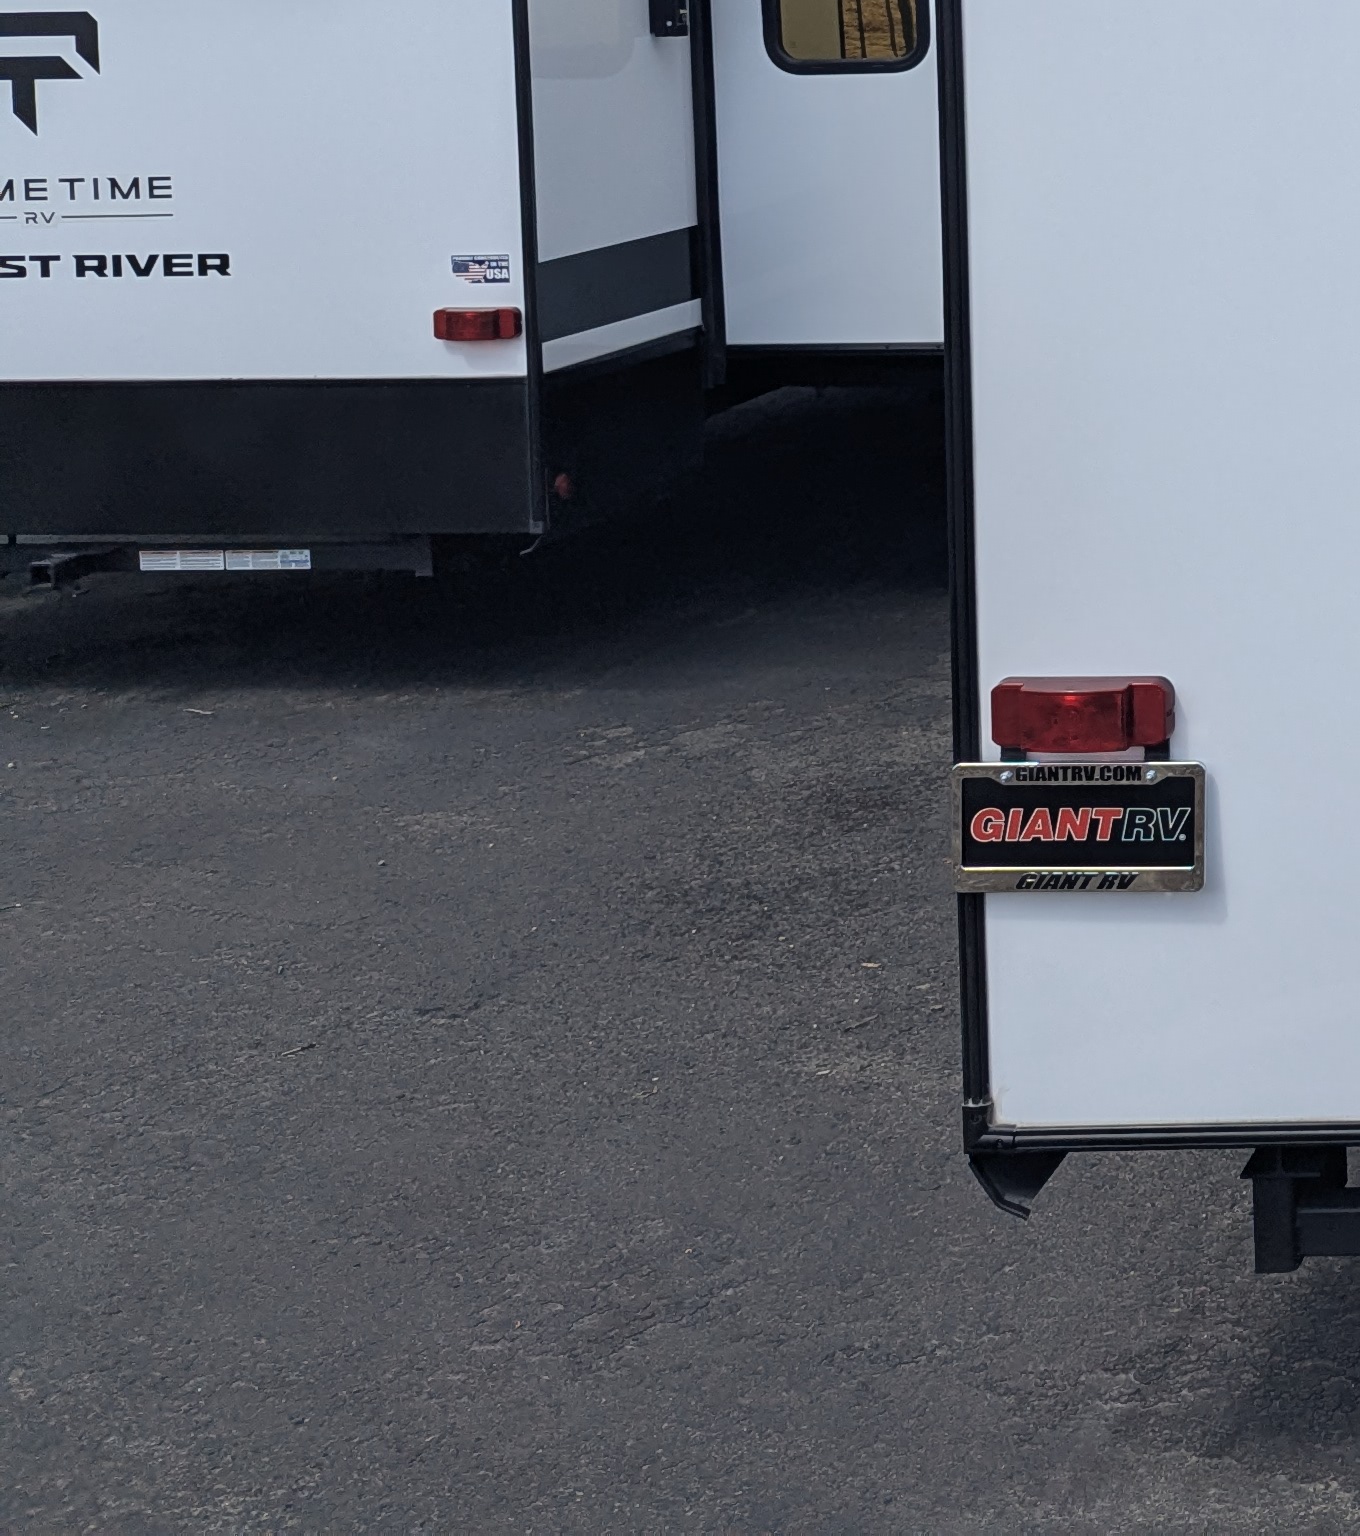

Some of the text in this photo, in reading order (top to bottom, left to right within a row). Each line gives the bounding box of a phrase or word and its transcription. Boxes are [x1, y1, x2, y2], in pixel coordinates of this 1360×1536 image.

[23, 211, 56, 225] RV
[72, 253, 232, 278] RIVER
[486, 268, 509, 280] USA
[1015, 765, 1142, 783] GIANTRV.COM
[1015, 872, 1139, 891] GIANT RV
